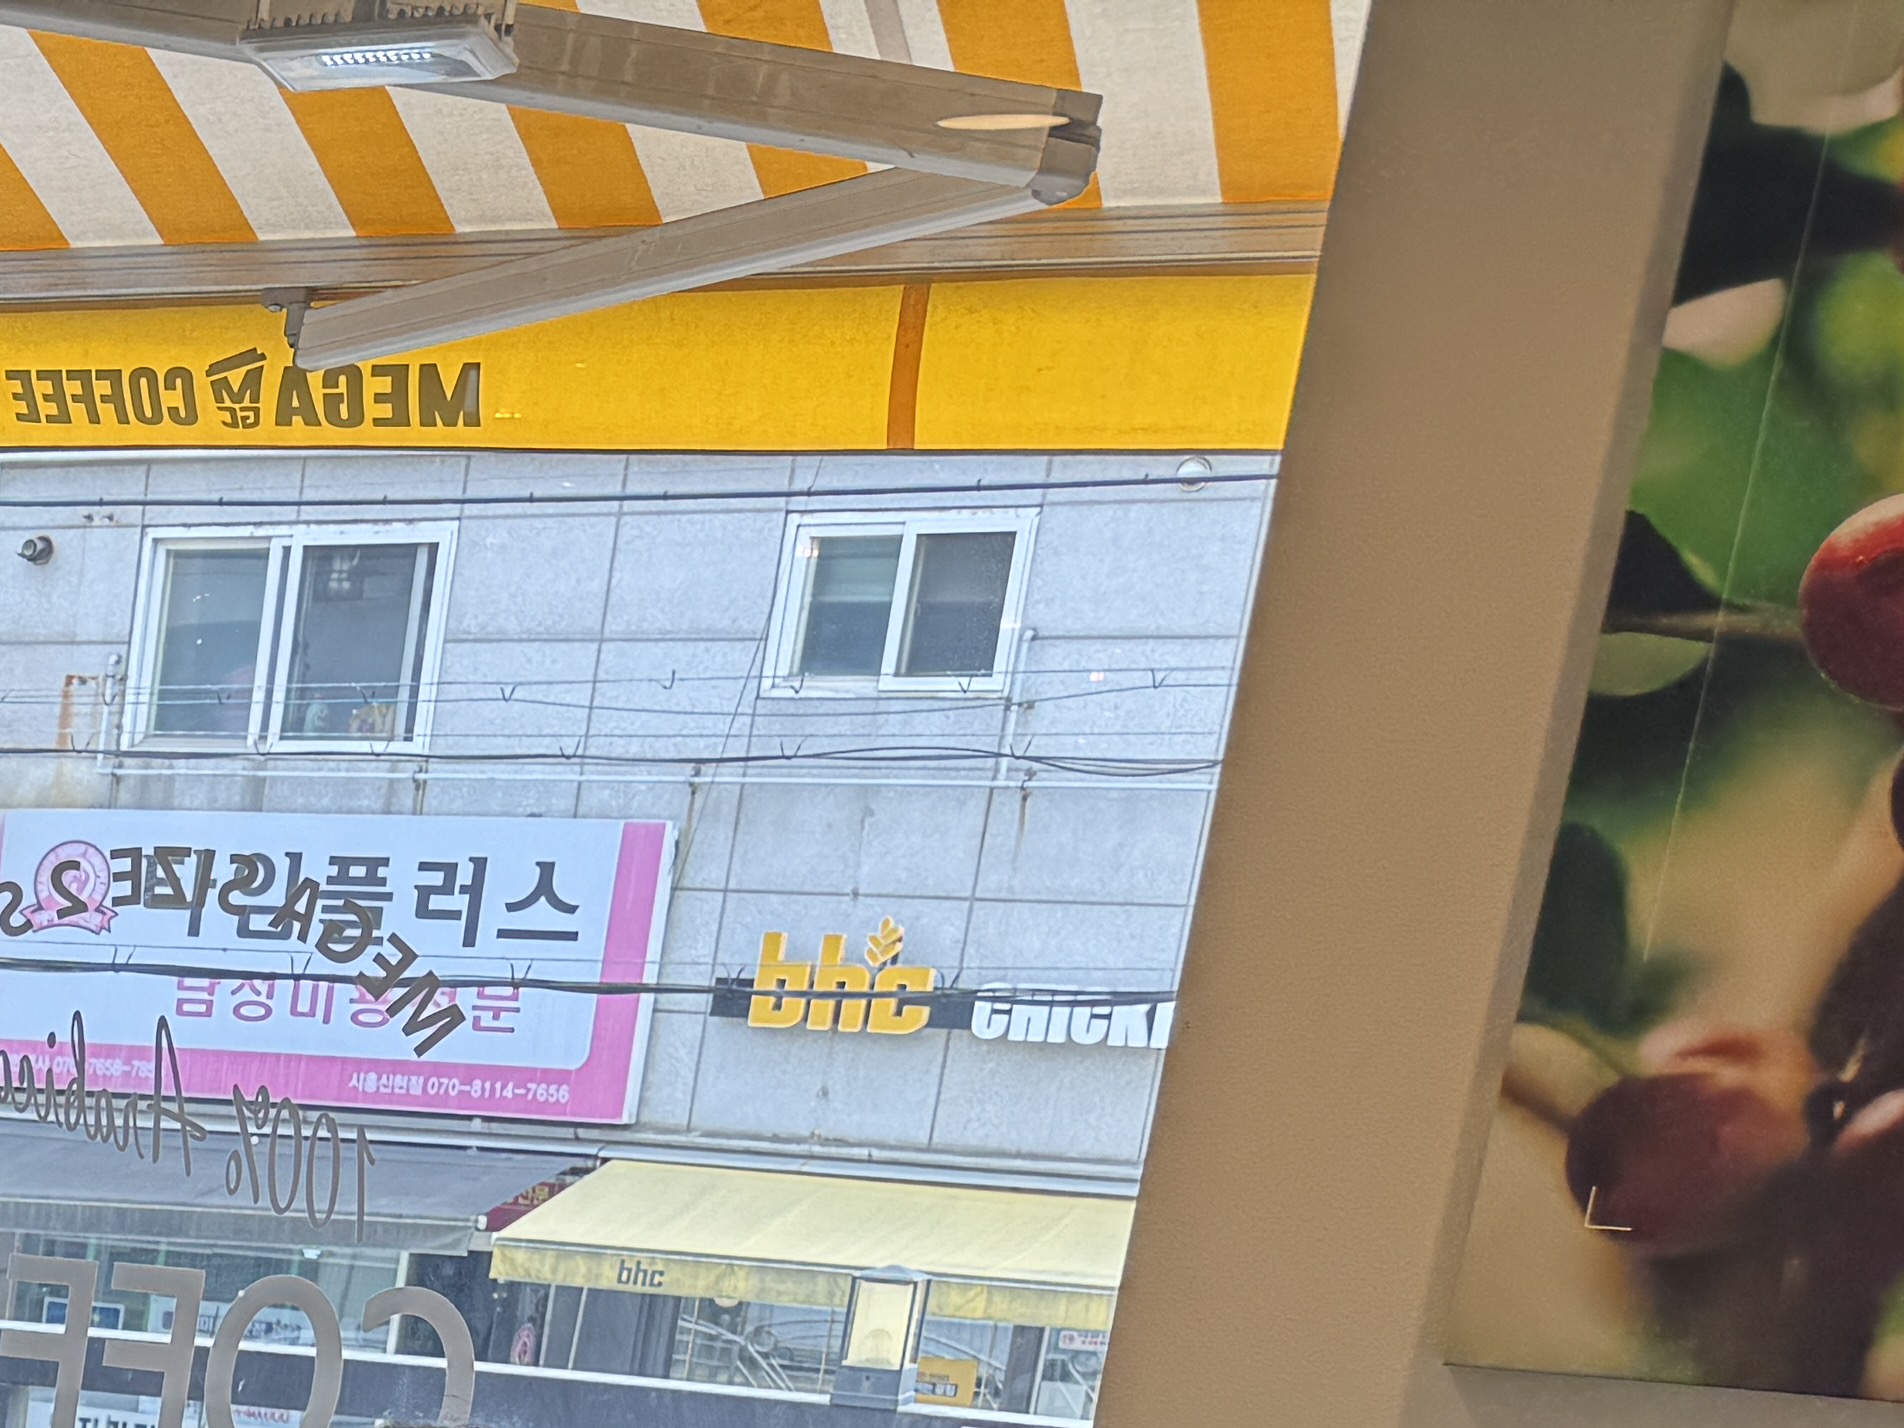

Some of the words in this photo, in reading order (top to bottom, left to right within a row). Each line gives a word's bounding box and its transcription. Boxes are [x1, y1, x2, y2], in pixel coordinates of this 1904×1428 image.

[747, 930, 937, 1035] bhc
[426, 1075, 570, 1104] 070-8114-7656
[616, 1258, 665, 1289] bhc
